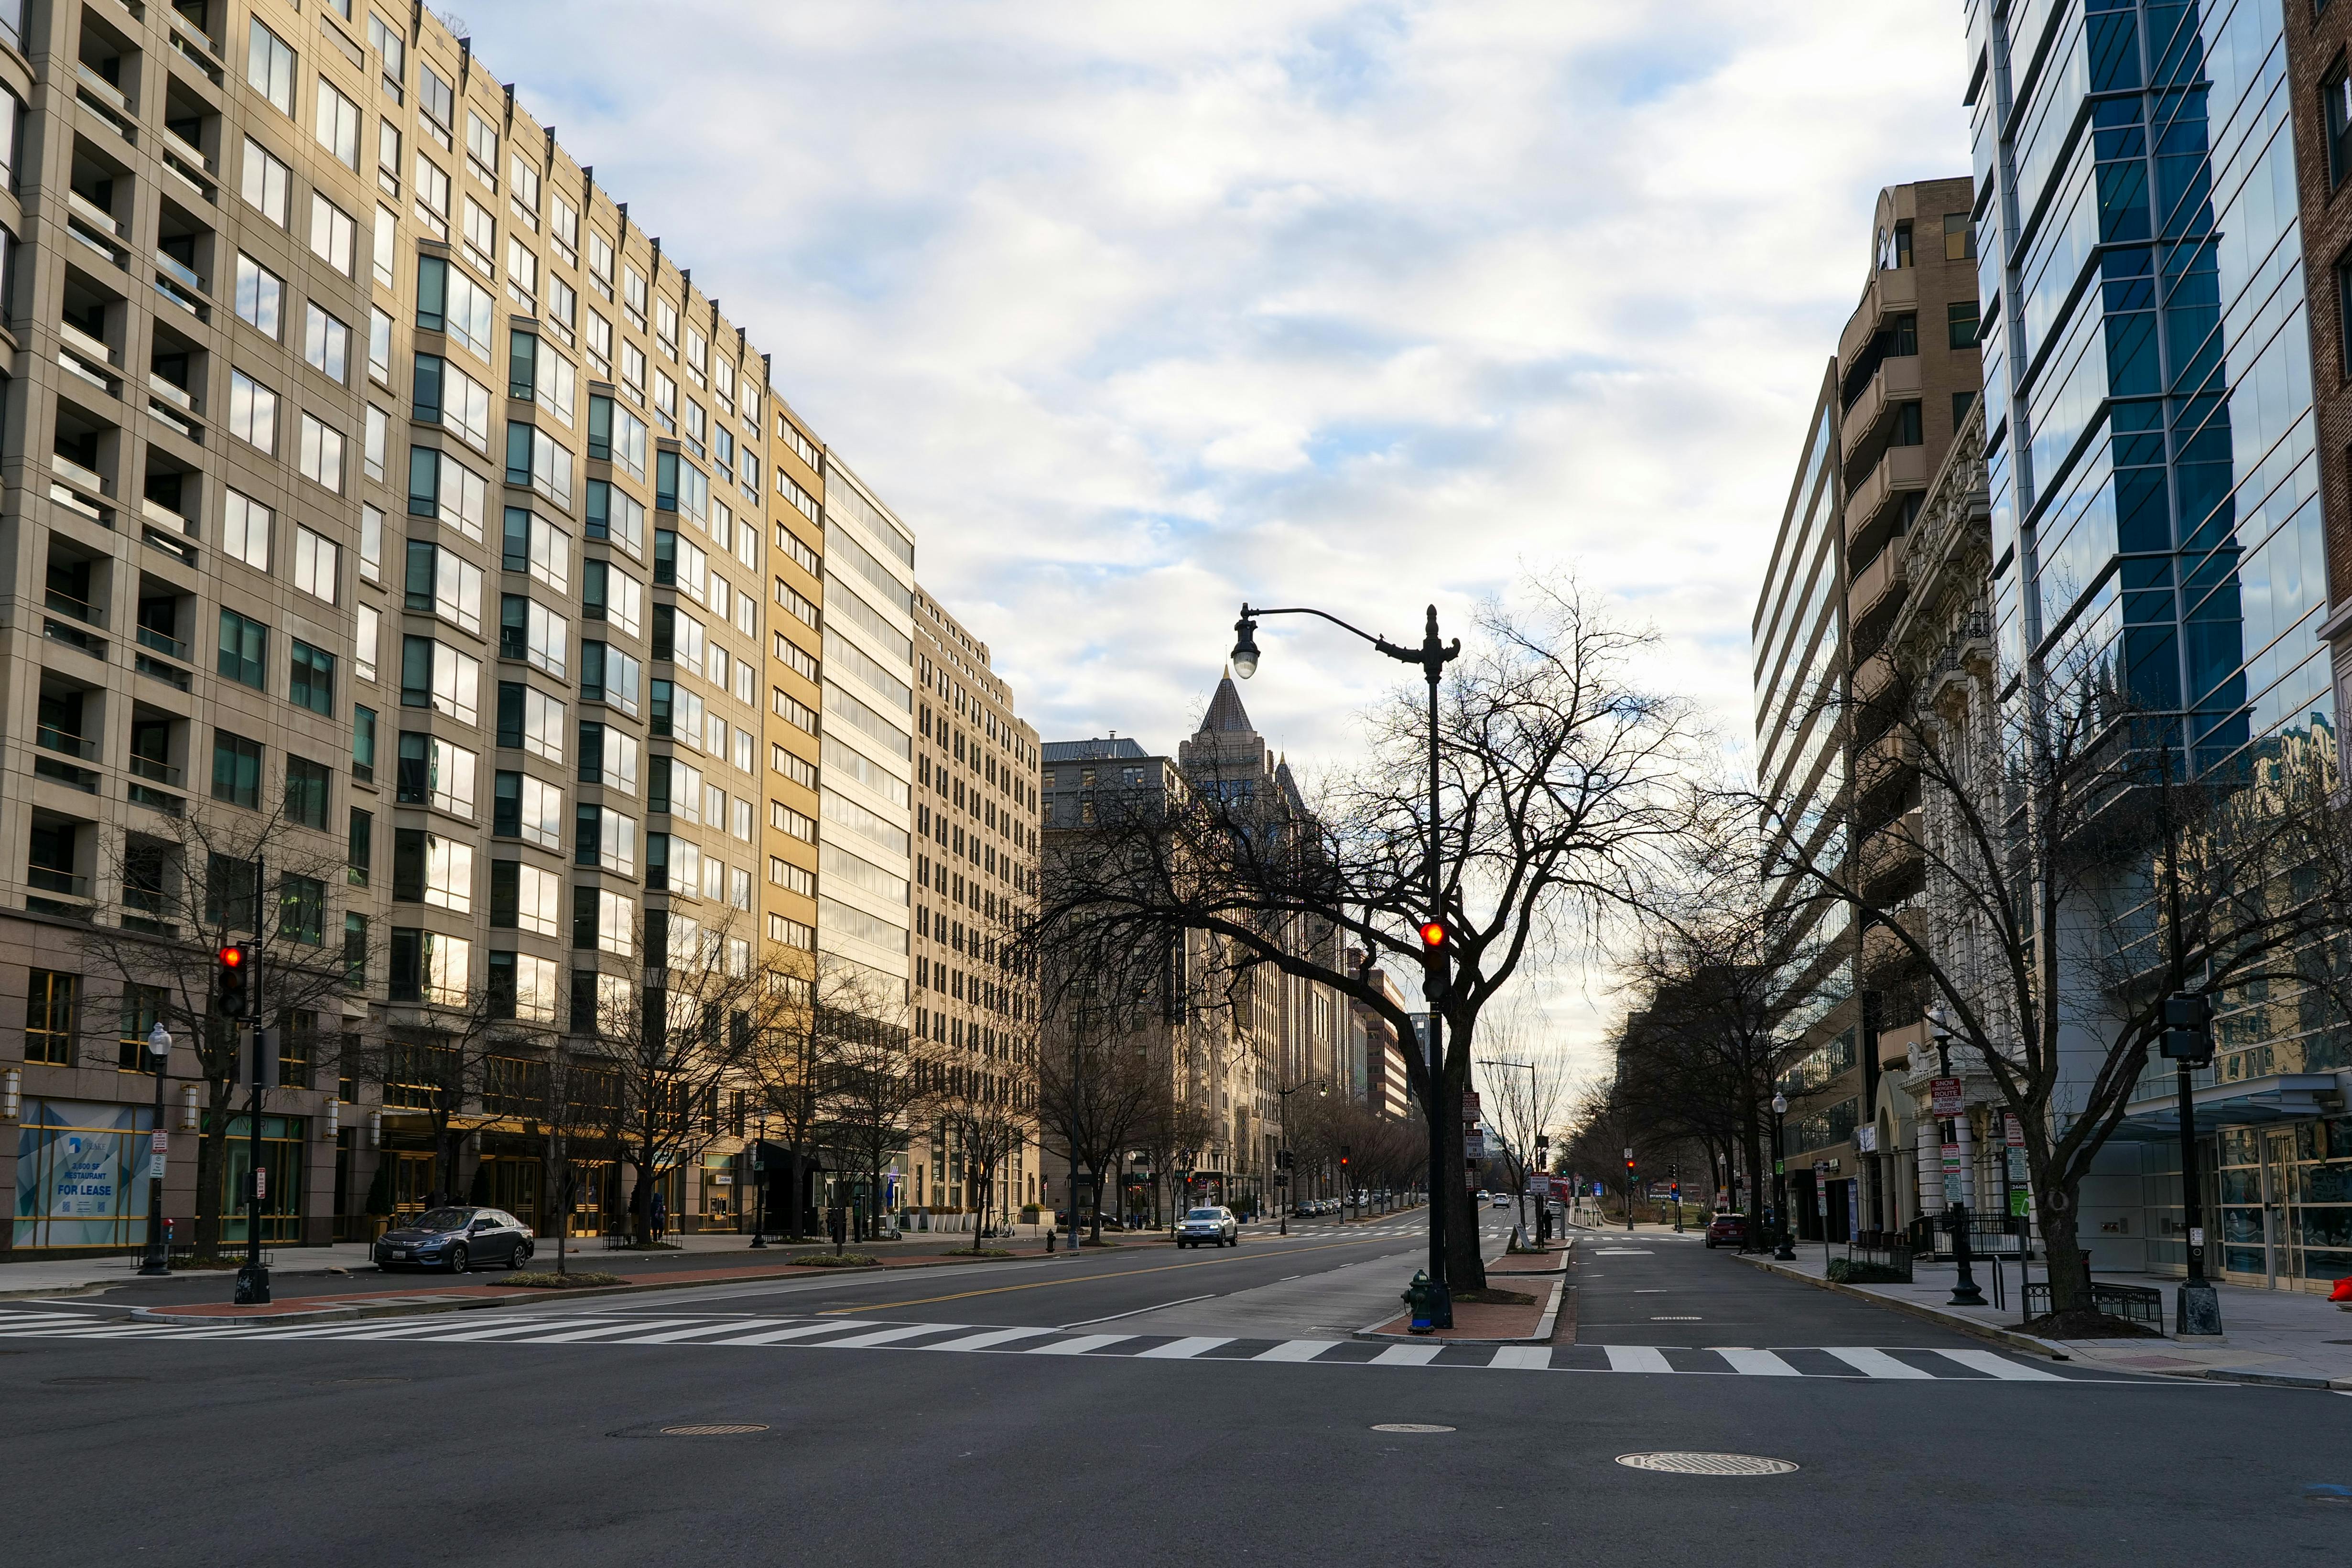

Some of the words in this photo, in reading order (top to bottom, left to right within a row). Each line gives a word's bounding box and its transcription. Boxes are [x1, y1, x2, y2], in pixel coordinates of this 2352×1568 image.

[237, 1118, 269, 1131] INRI
[57, 1185, 77, 1195] FOR
[80, 1185, 111, 1196] LEASE
